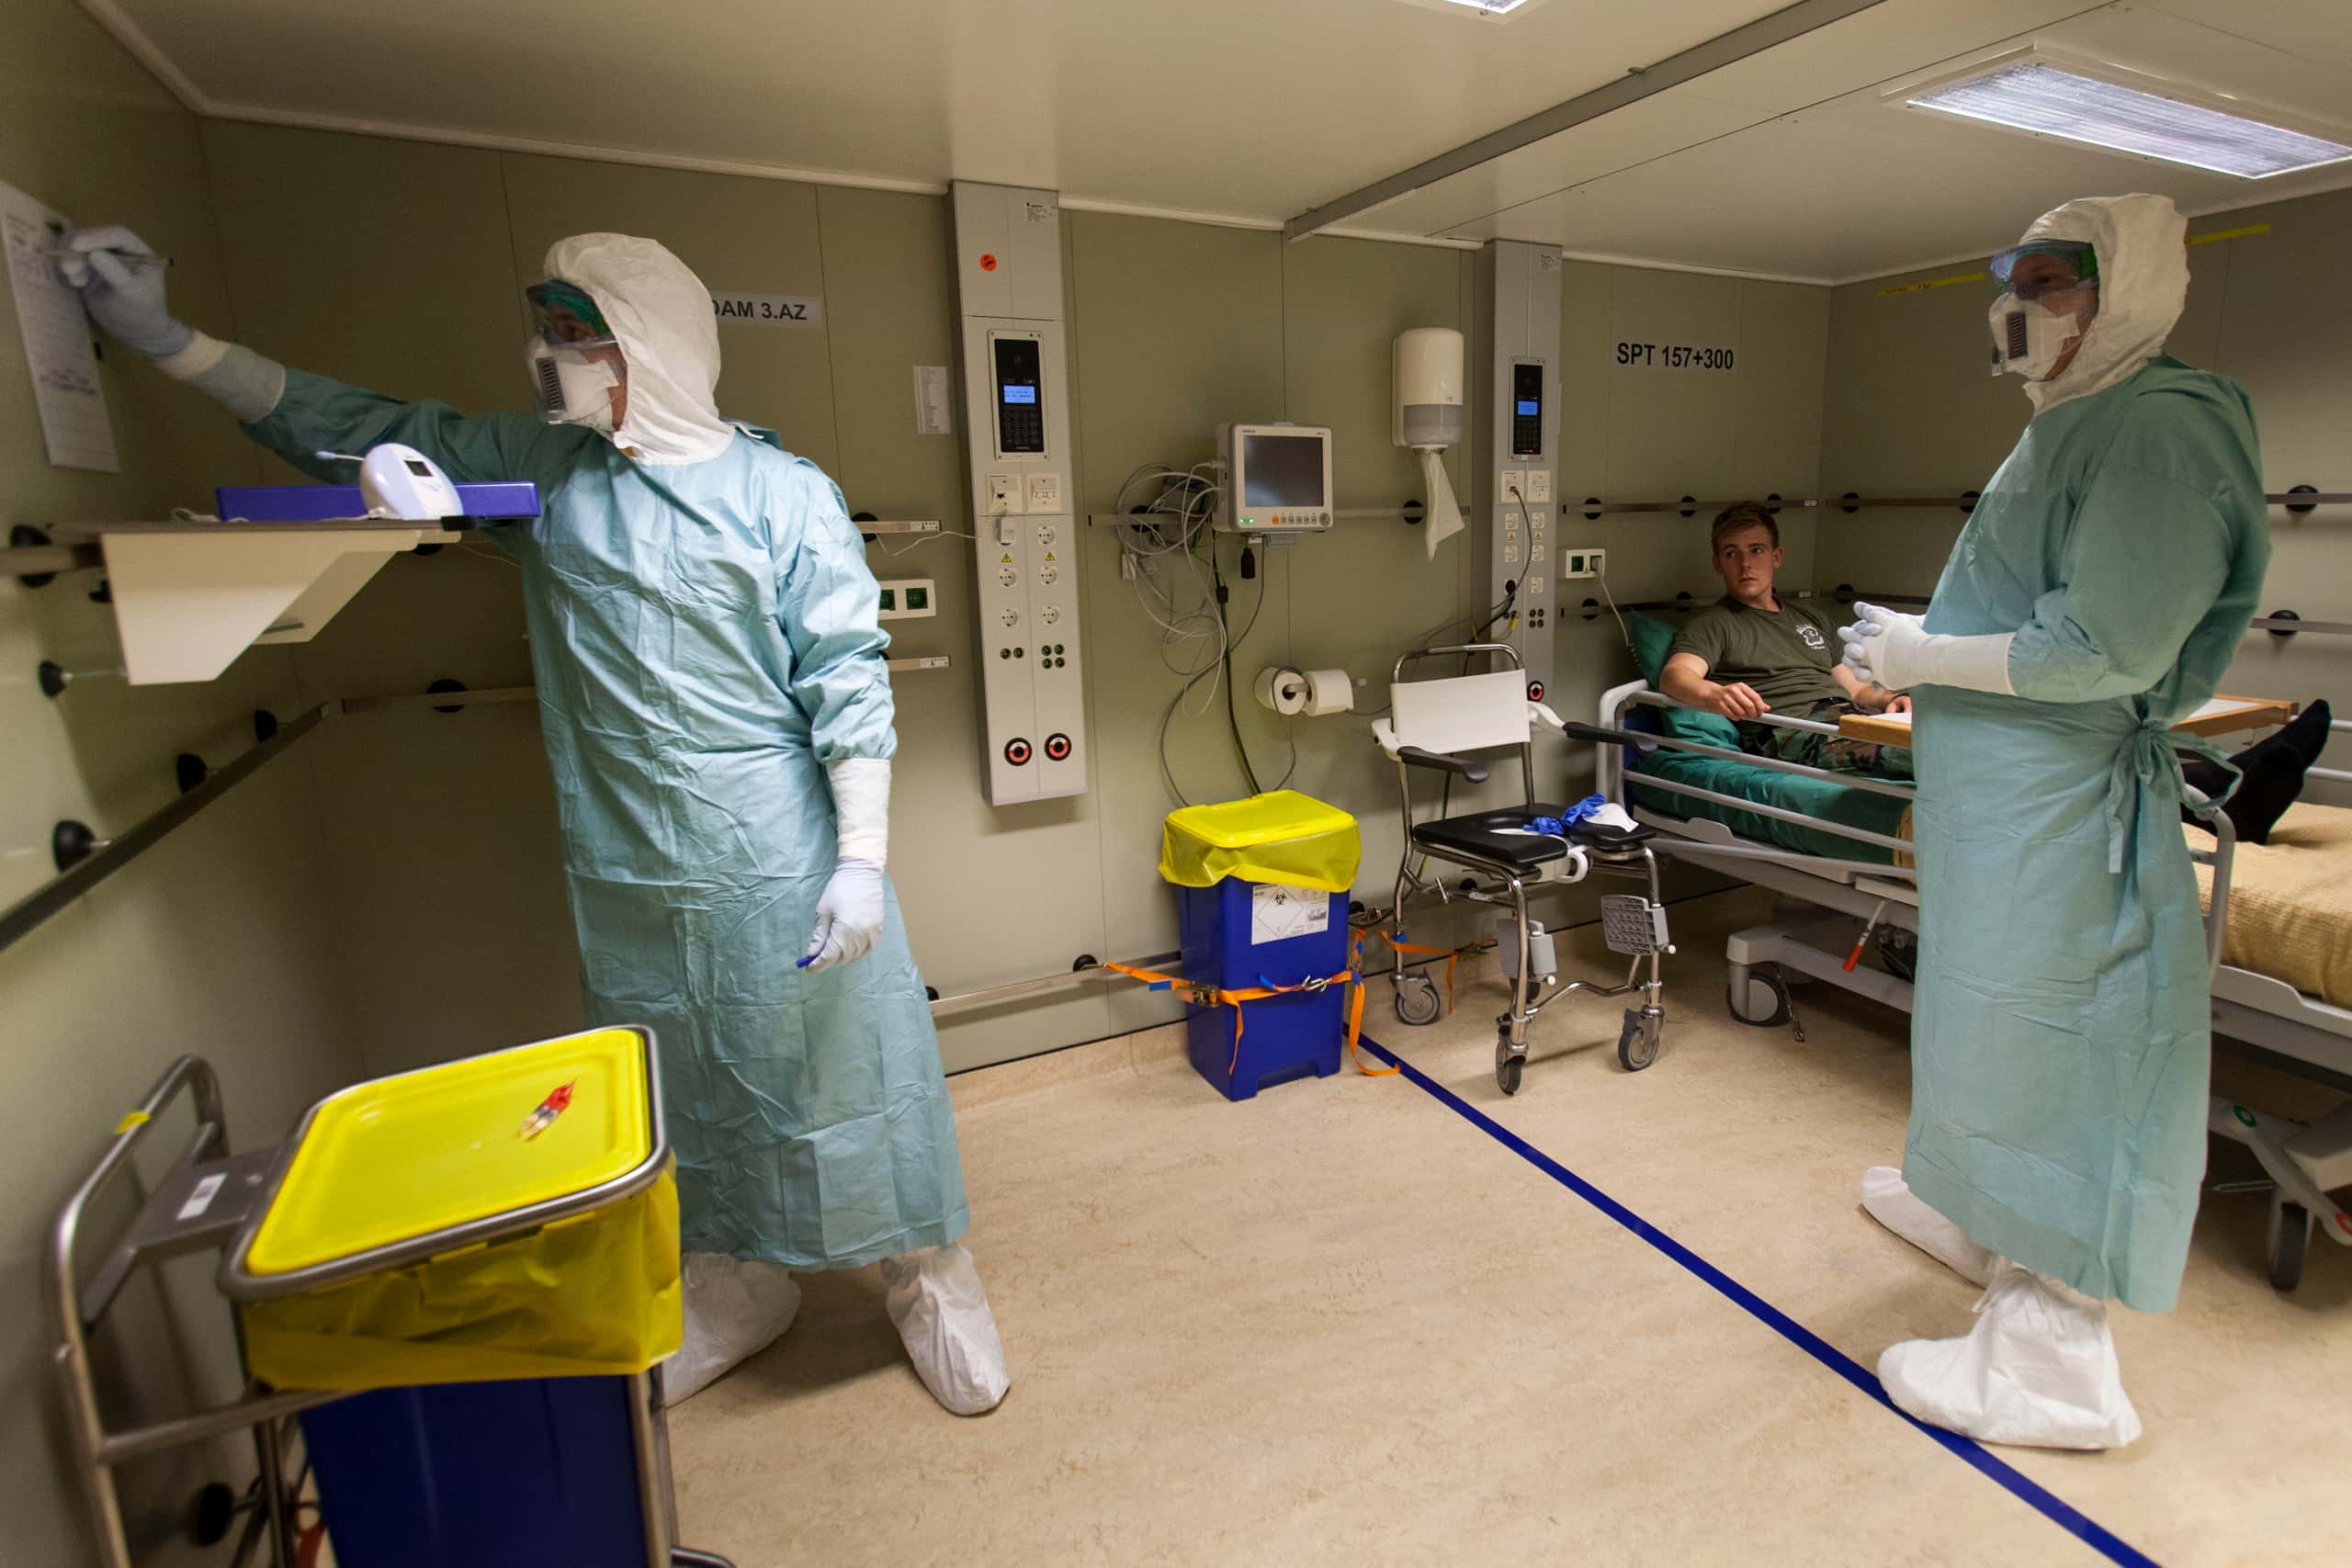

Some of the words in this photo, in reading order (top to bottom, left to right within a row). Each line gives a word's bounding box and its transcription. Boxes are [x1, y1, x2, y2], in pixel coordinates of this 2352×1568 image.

[761, 302, 808, 321] 3.AZ
[1617, 343, 1656, 366] SPT
[1661, 345, 1735, 369] 157+300
